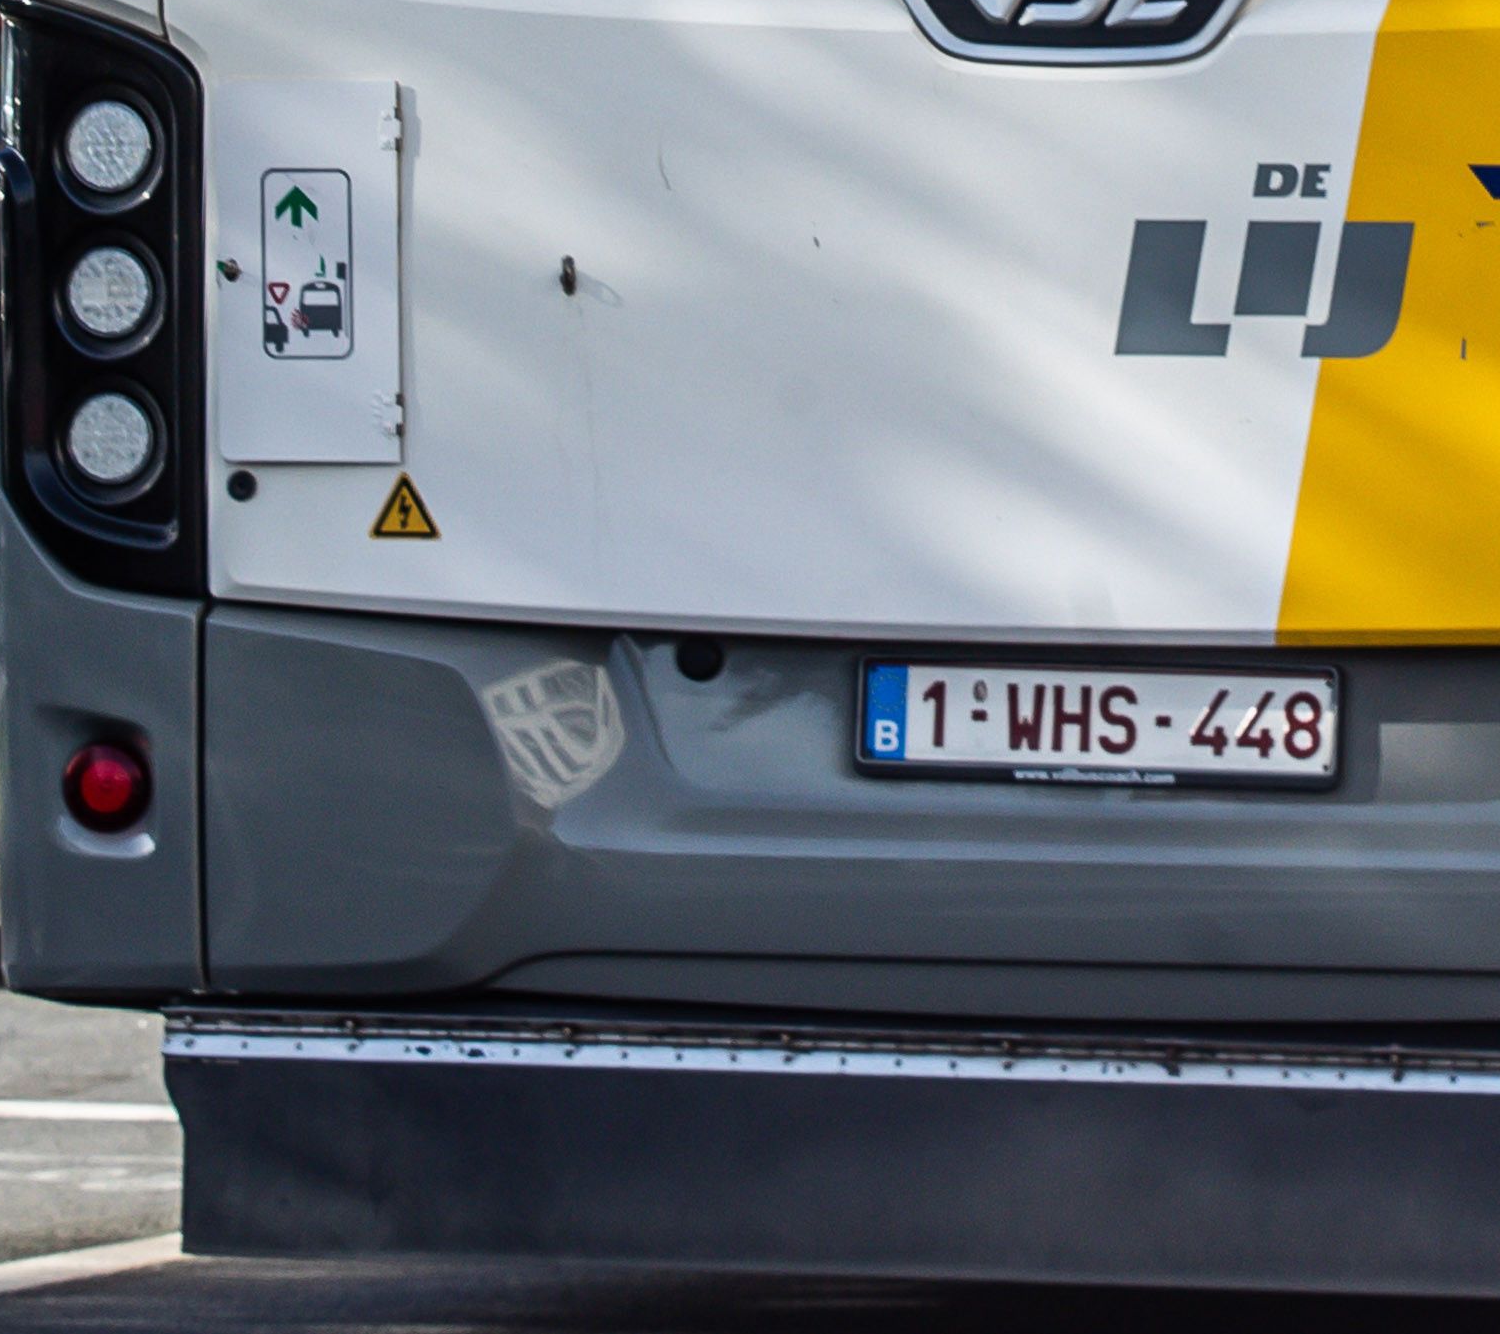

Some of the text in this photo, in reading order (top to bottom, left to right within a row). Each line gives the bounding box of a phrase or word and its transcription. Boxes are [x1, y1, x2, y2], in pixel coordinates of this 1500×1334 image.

[1252, 162, 1331, 198] DE
[875, 679, 1322, 760] B 1-WHS-448
